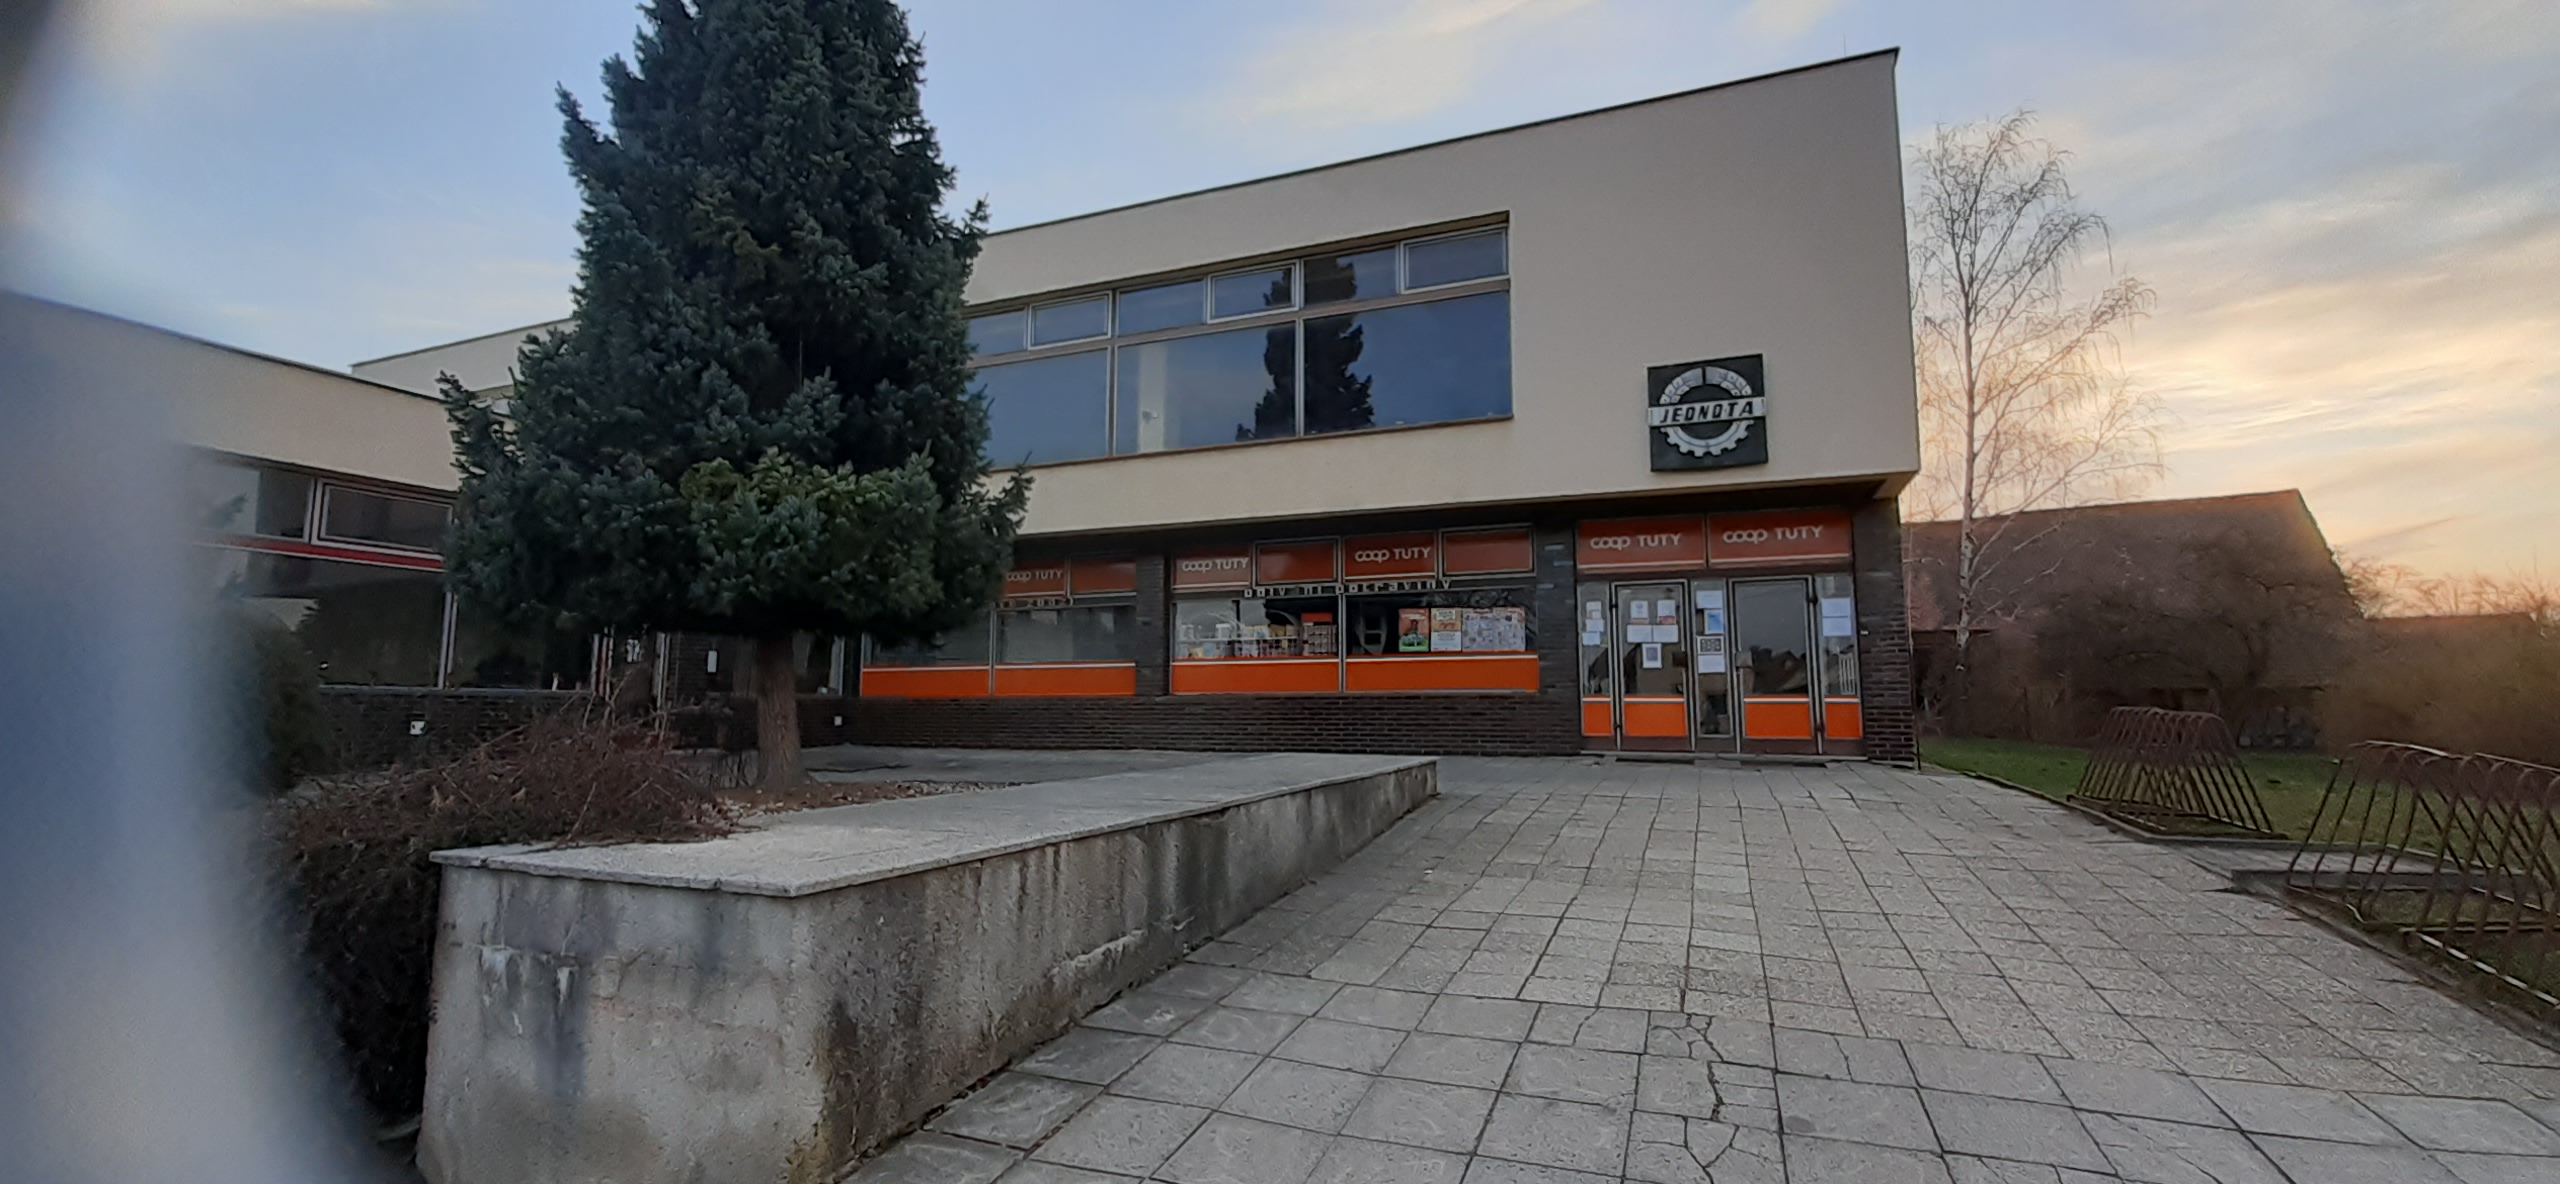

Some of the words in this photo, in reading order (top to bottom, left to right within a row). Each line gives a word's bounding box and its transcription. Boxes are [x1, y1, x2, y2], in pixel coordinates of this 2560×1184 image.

[1659, 400, 1754, 424] JEDNOTA
[1774, 525, 1824, 541] TUTY
[1637, 533, 1682, 548] TUTY
[1393, 547, 1431, 560] TUTY
[1215, 557, 1250, 570] TUTY
[1035, 569, 1063, 580] TUTY
